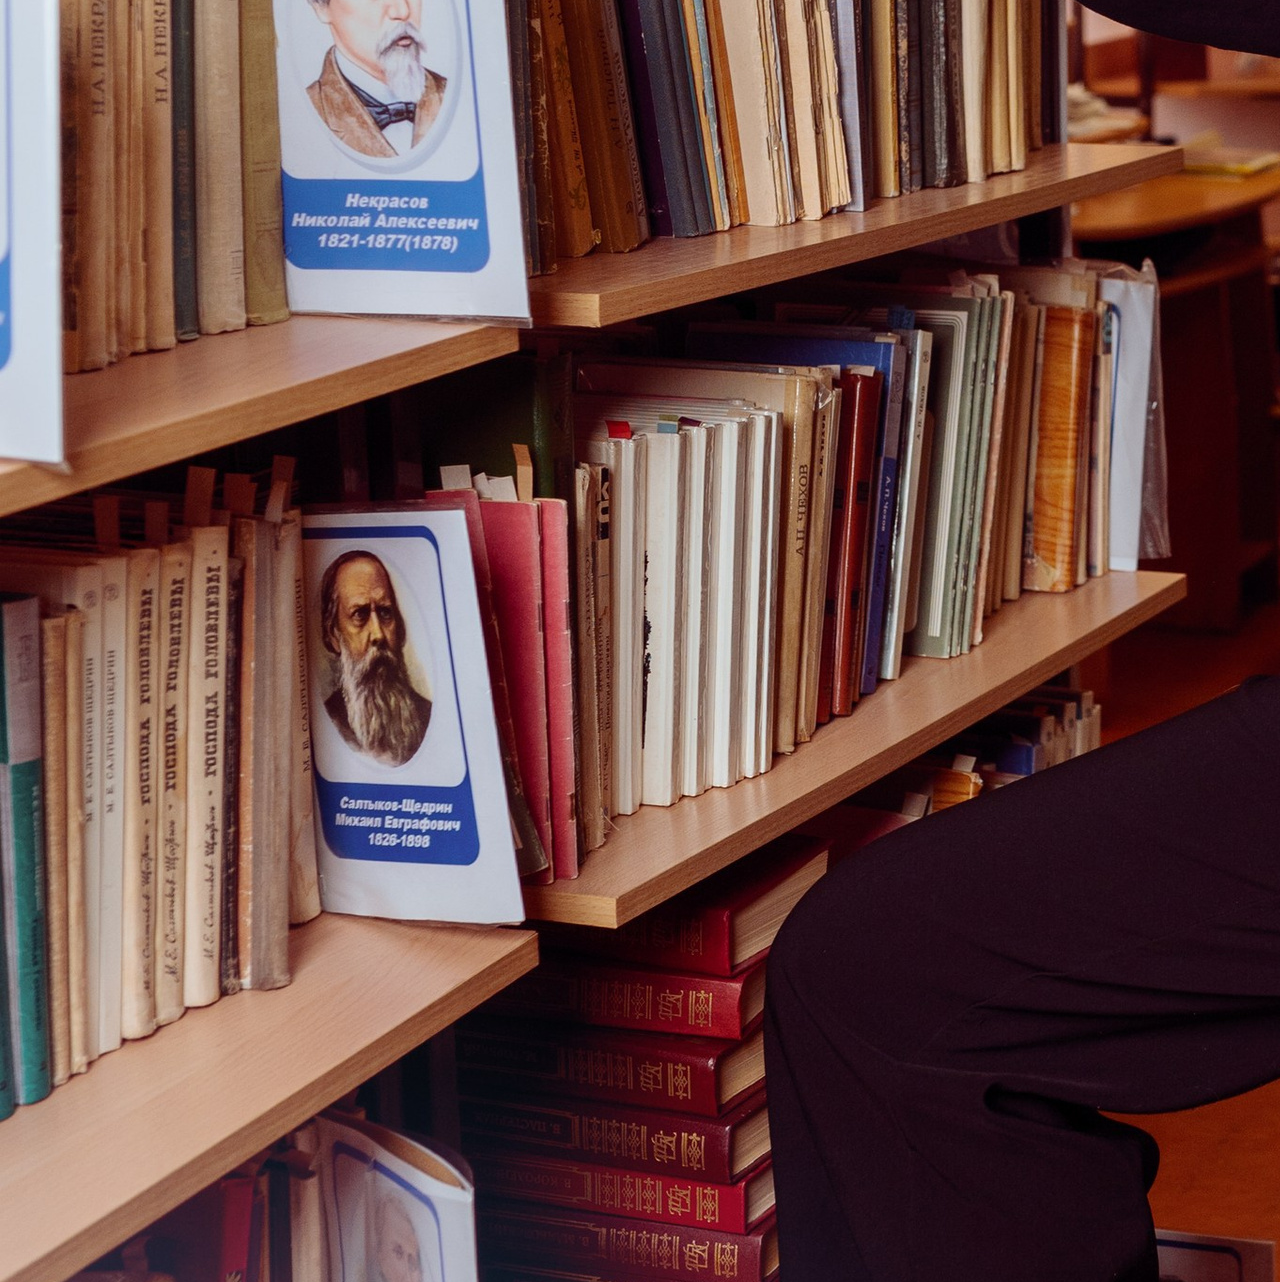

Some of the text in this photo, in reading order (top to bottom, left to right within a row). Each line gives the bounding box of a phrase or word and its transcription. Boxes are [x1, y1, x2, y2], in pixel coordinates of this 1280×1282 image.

[90, 73, 105, 115] Н.А.
[153, 61, 167, 103] Н.А.
[291, 213, 479, 230] Николай Алексеевич
[345, 193, 429, 211] Некрасов
[318, 233, 458, 254] 1821-1877(1878)
[796, 463, 809, 523] ЧЕХОВ
[165, 577, 185, 693] ГОЛОВЛЕВЫ
[204, 565, 221, 680] ГОЛОВЛЕВЫ
[139, 588, 153, 805] ГОСПОДА ГОЛОВЛЕВЫ
[164, 704, 179, 792] ГОСПОДА
[203, 691, 219, 777] ГОСПОДА
[335, 813, 461, 832] Михаил Евграфович
[340, 796, 454, 816] Салтыков-Щедрин
[368, 833, 430, 849] 1826-1898
